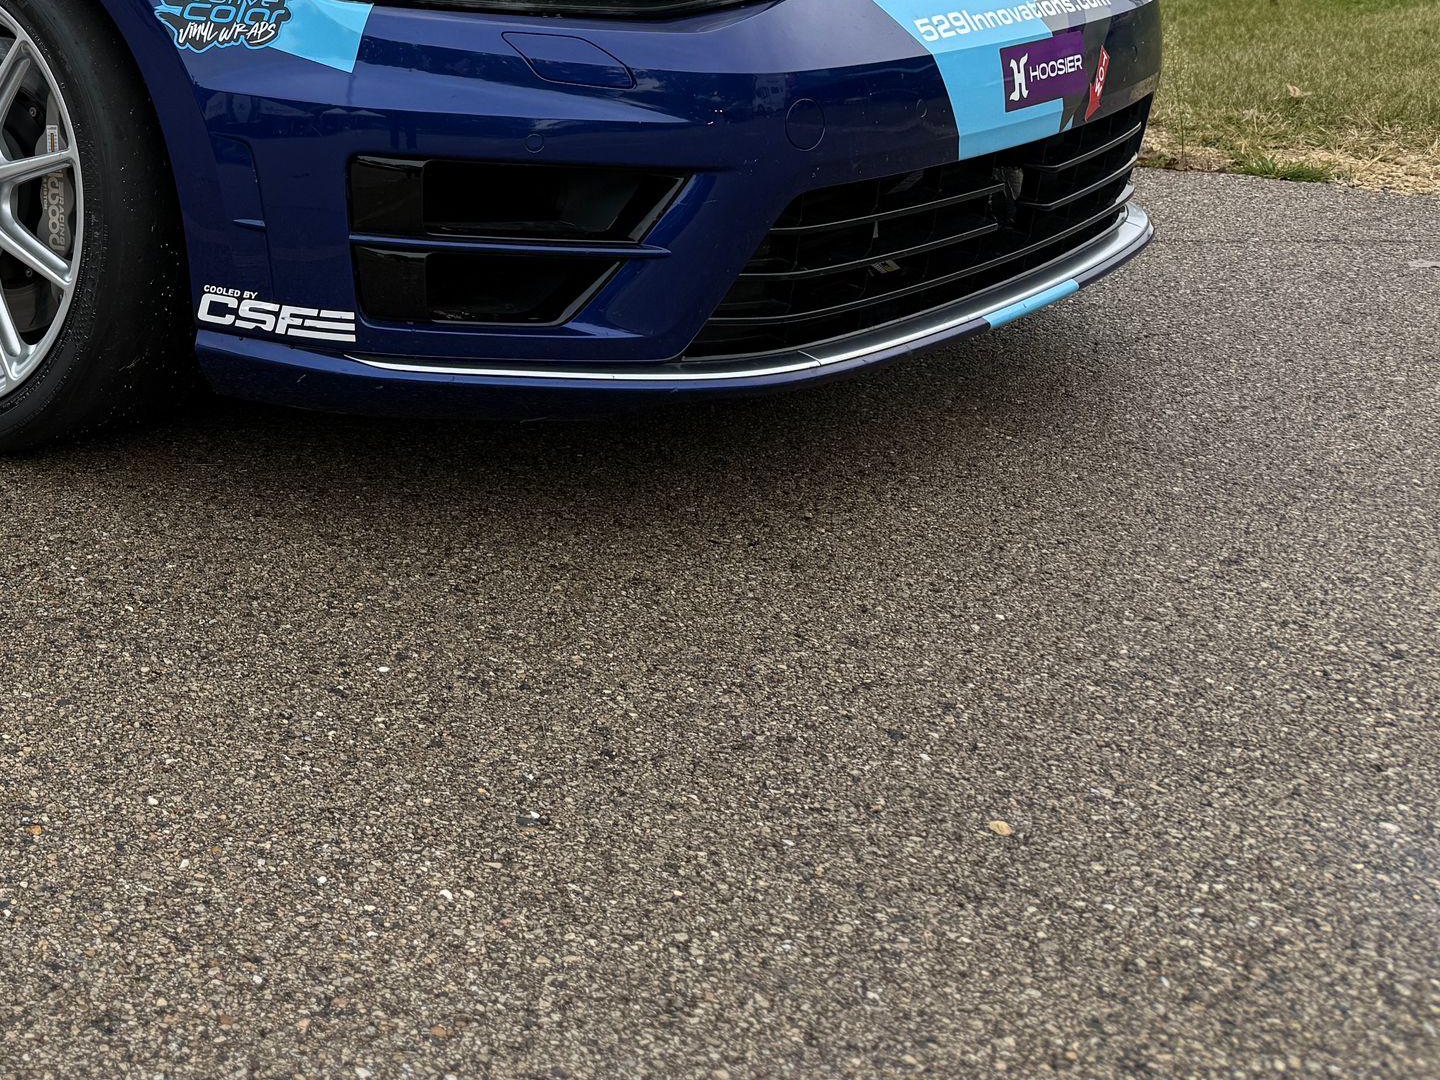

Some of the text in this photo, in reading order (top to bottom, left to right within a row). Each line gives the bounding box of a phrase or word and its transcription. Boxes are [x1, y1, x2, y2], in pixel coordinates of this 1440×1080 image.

[1029, 54, 1083, 82] HOOSIER
[1094, 52, 1108, 96] TOW
[203, 285, 258, 299] COOLED BY
